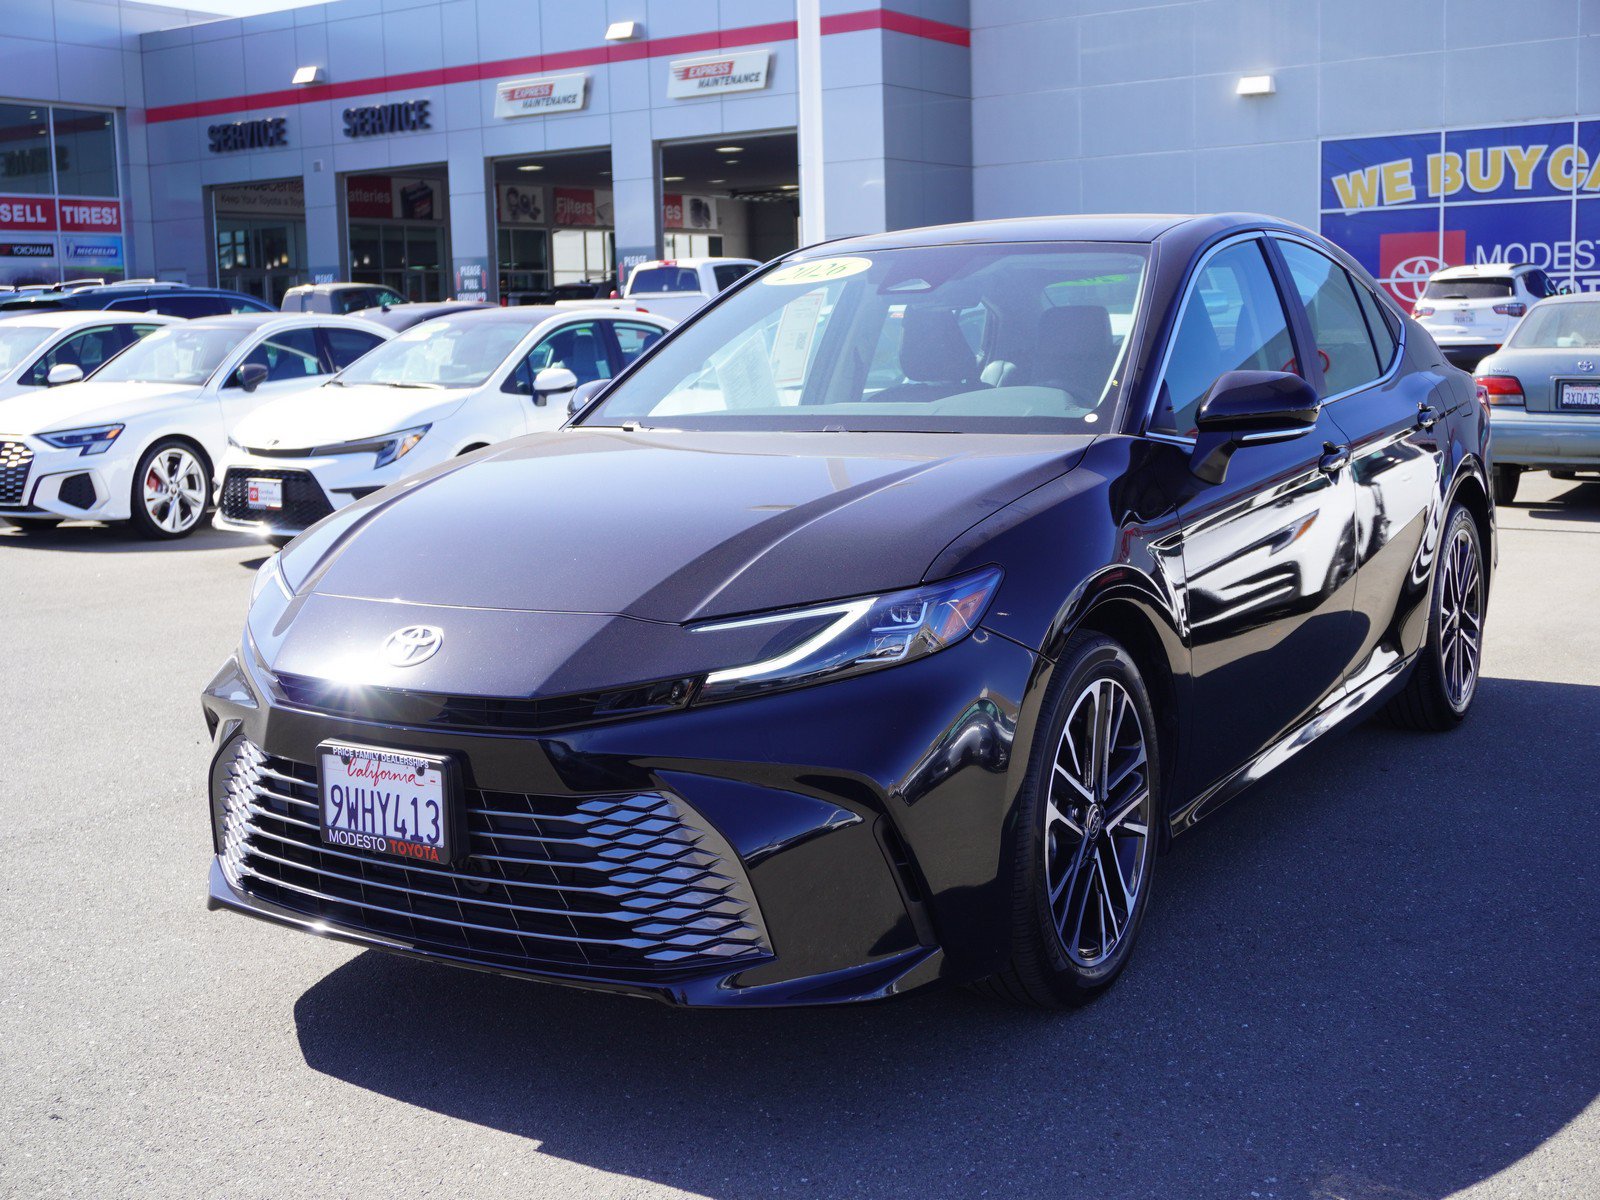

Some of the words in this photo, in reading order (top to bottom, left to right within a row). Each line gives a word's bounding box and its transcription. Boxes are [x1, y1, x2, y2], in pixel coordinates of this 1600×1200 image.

[688, 63, 731, 77] EXPRESS
[698, 72, 762, 88] MAINTENANCE
[513, 85, 552, 99] EXPRESS
[522, 94, 578, 109] MAINTENANCE
[343, 99, 431, 138] SERVICE
[208, 117, 288, 153] SERVICE
[1332, 158, 1416, 216] WE
[1427, 145, 1548, 198] BUY
[349, 189, 391, 204] atteries
[0, 203, 47, 223] SELL
[61, 205, 118, 225] TIRES!
[556, 197, 593, 216] Filters
[11, 245, 52, 256] YOKOHAMA
[76, 247, 117, 257] MICHELIN
[460, 265, 481, 276] PLEASE
[464, 279, 479, 290] PULL
[1565, 392, 1600, 405] 3XDA75
[332, 747, 354, 758] PRICE
[354, 750, 380, 761] FAMILY
[381, 754, 429, 769] DEALERSHIPS
[347, 757, 425, 787] California
[330, 784, 440, 845] 9WHY413
[328, 829, 387, 852] MODESTO
[389, 839, 440, 862] TOYOTA
